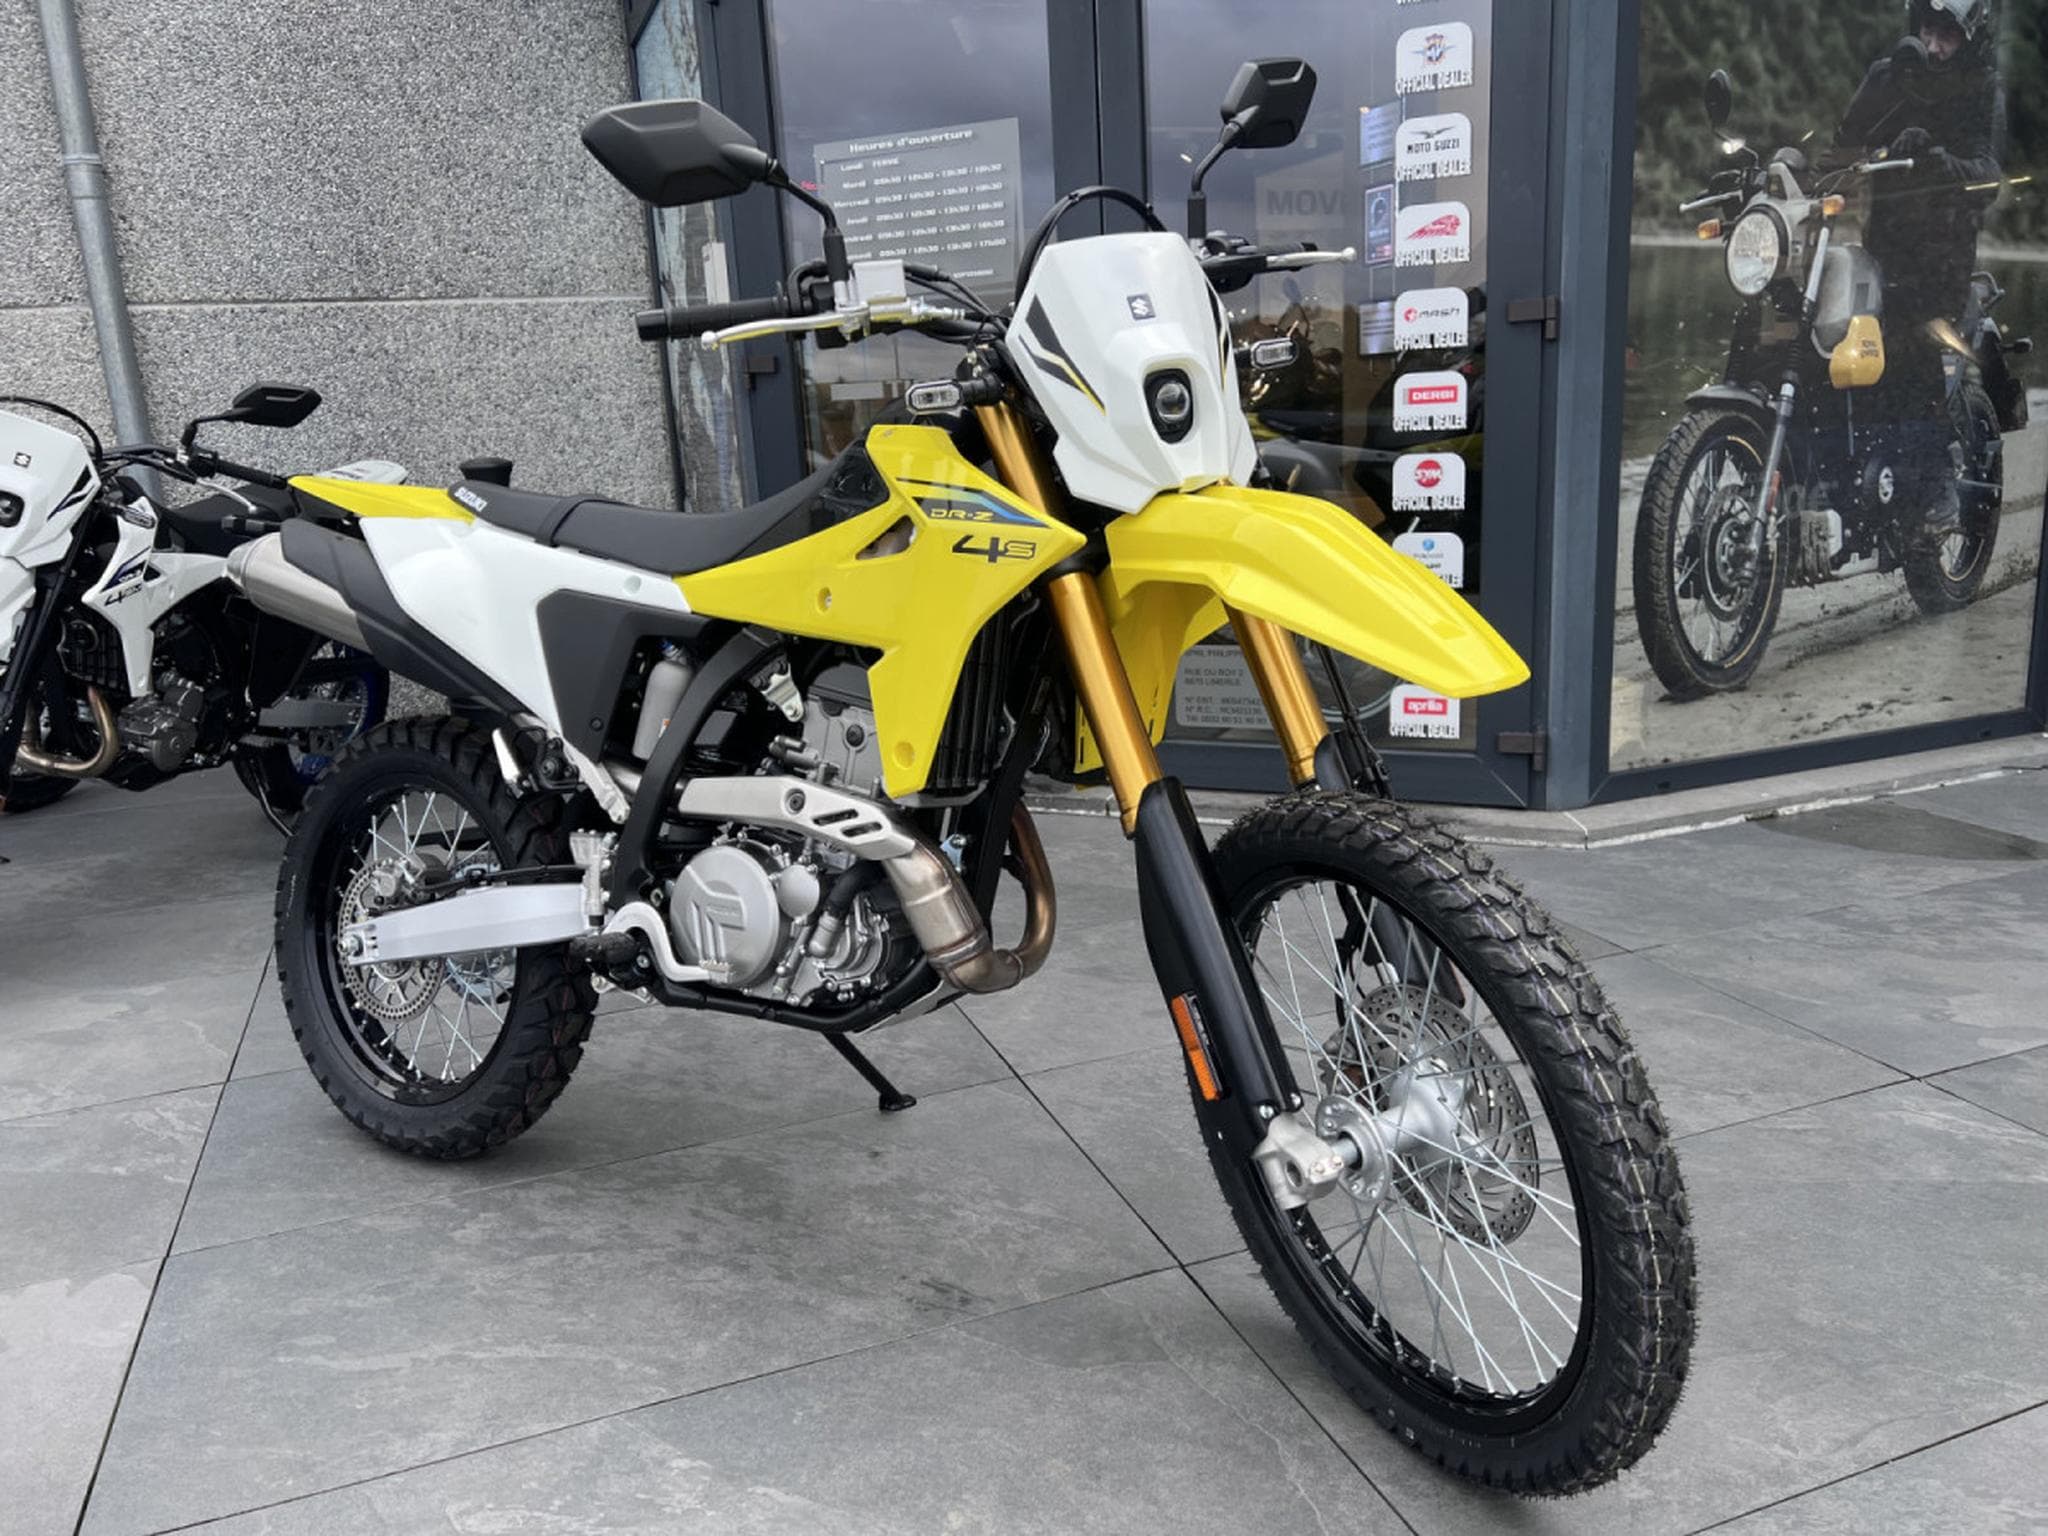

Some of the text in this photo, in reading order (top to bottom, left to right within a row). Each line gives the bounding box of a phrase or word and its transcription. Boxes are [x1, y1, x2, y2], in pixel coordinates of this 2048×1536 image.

[1395, 69, 1473, 96] OFFICIAL DEALER
[849, 129, 973, 154] Heures d'ouverture
[1406, 138, 1460, 154] MOTO GUZZI
[1393, 414, 1467, 432] OFFICIAL DEALER
[1392, 495, 1465, 511] OFFICIAL DEALER
[951, 534, 1037, 563] 4S
[1391, 722, 1460, 739] OFFICIAL DEALER
